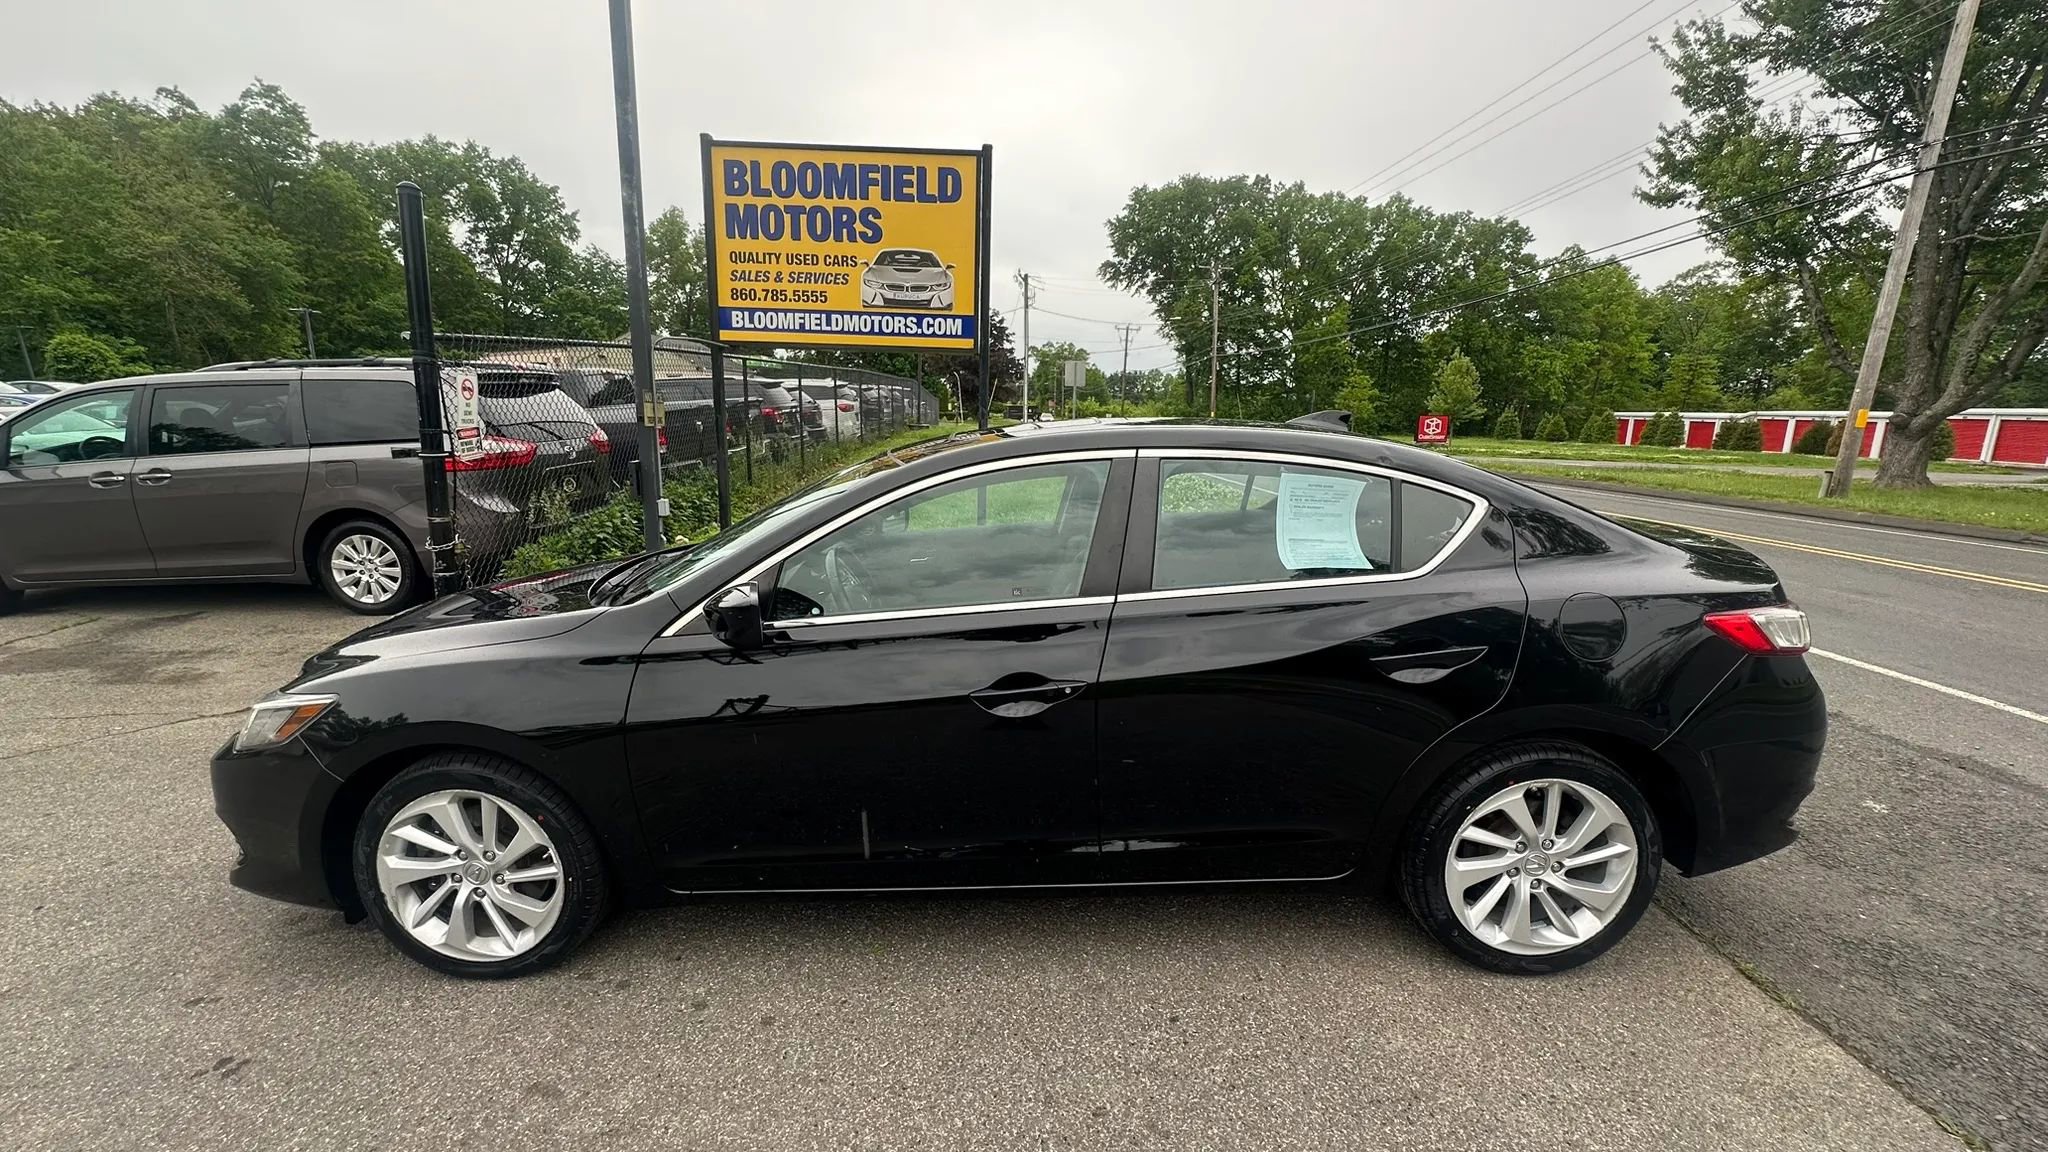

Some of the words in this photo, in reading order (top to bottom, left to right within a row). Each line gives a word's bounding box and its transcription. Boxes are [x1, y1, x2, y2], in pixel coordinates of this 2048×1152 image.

[723, 159, 963, 204] BLOOMFIELD
[725, 203, 884, 244] MOTORS
[729, 251, 782, 266] QUALITY
[786, 252, 819, 267] USED
[825, 254, 858, 268] CARS
[730, 270, 770, 283] SALES
[774, 271, 784, 284] &
[788, 272, 849, 285] SERVICES
[730, 288, 828, 303] 860.785.5555
[731, 311, 962, 336] BLOOMFIELDMOTORS.COM
